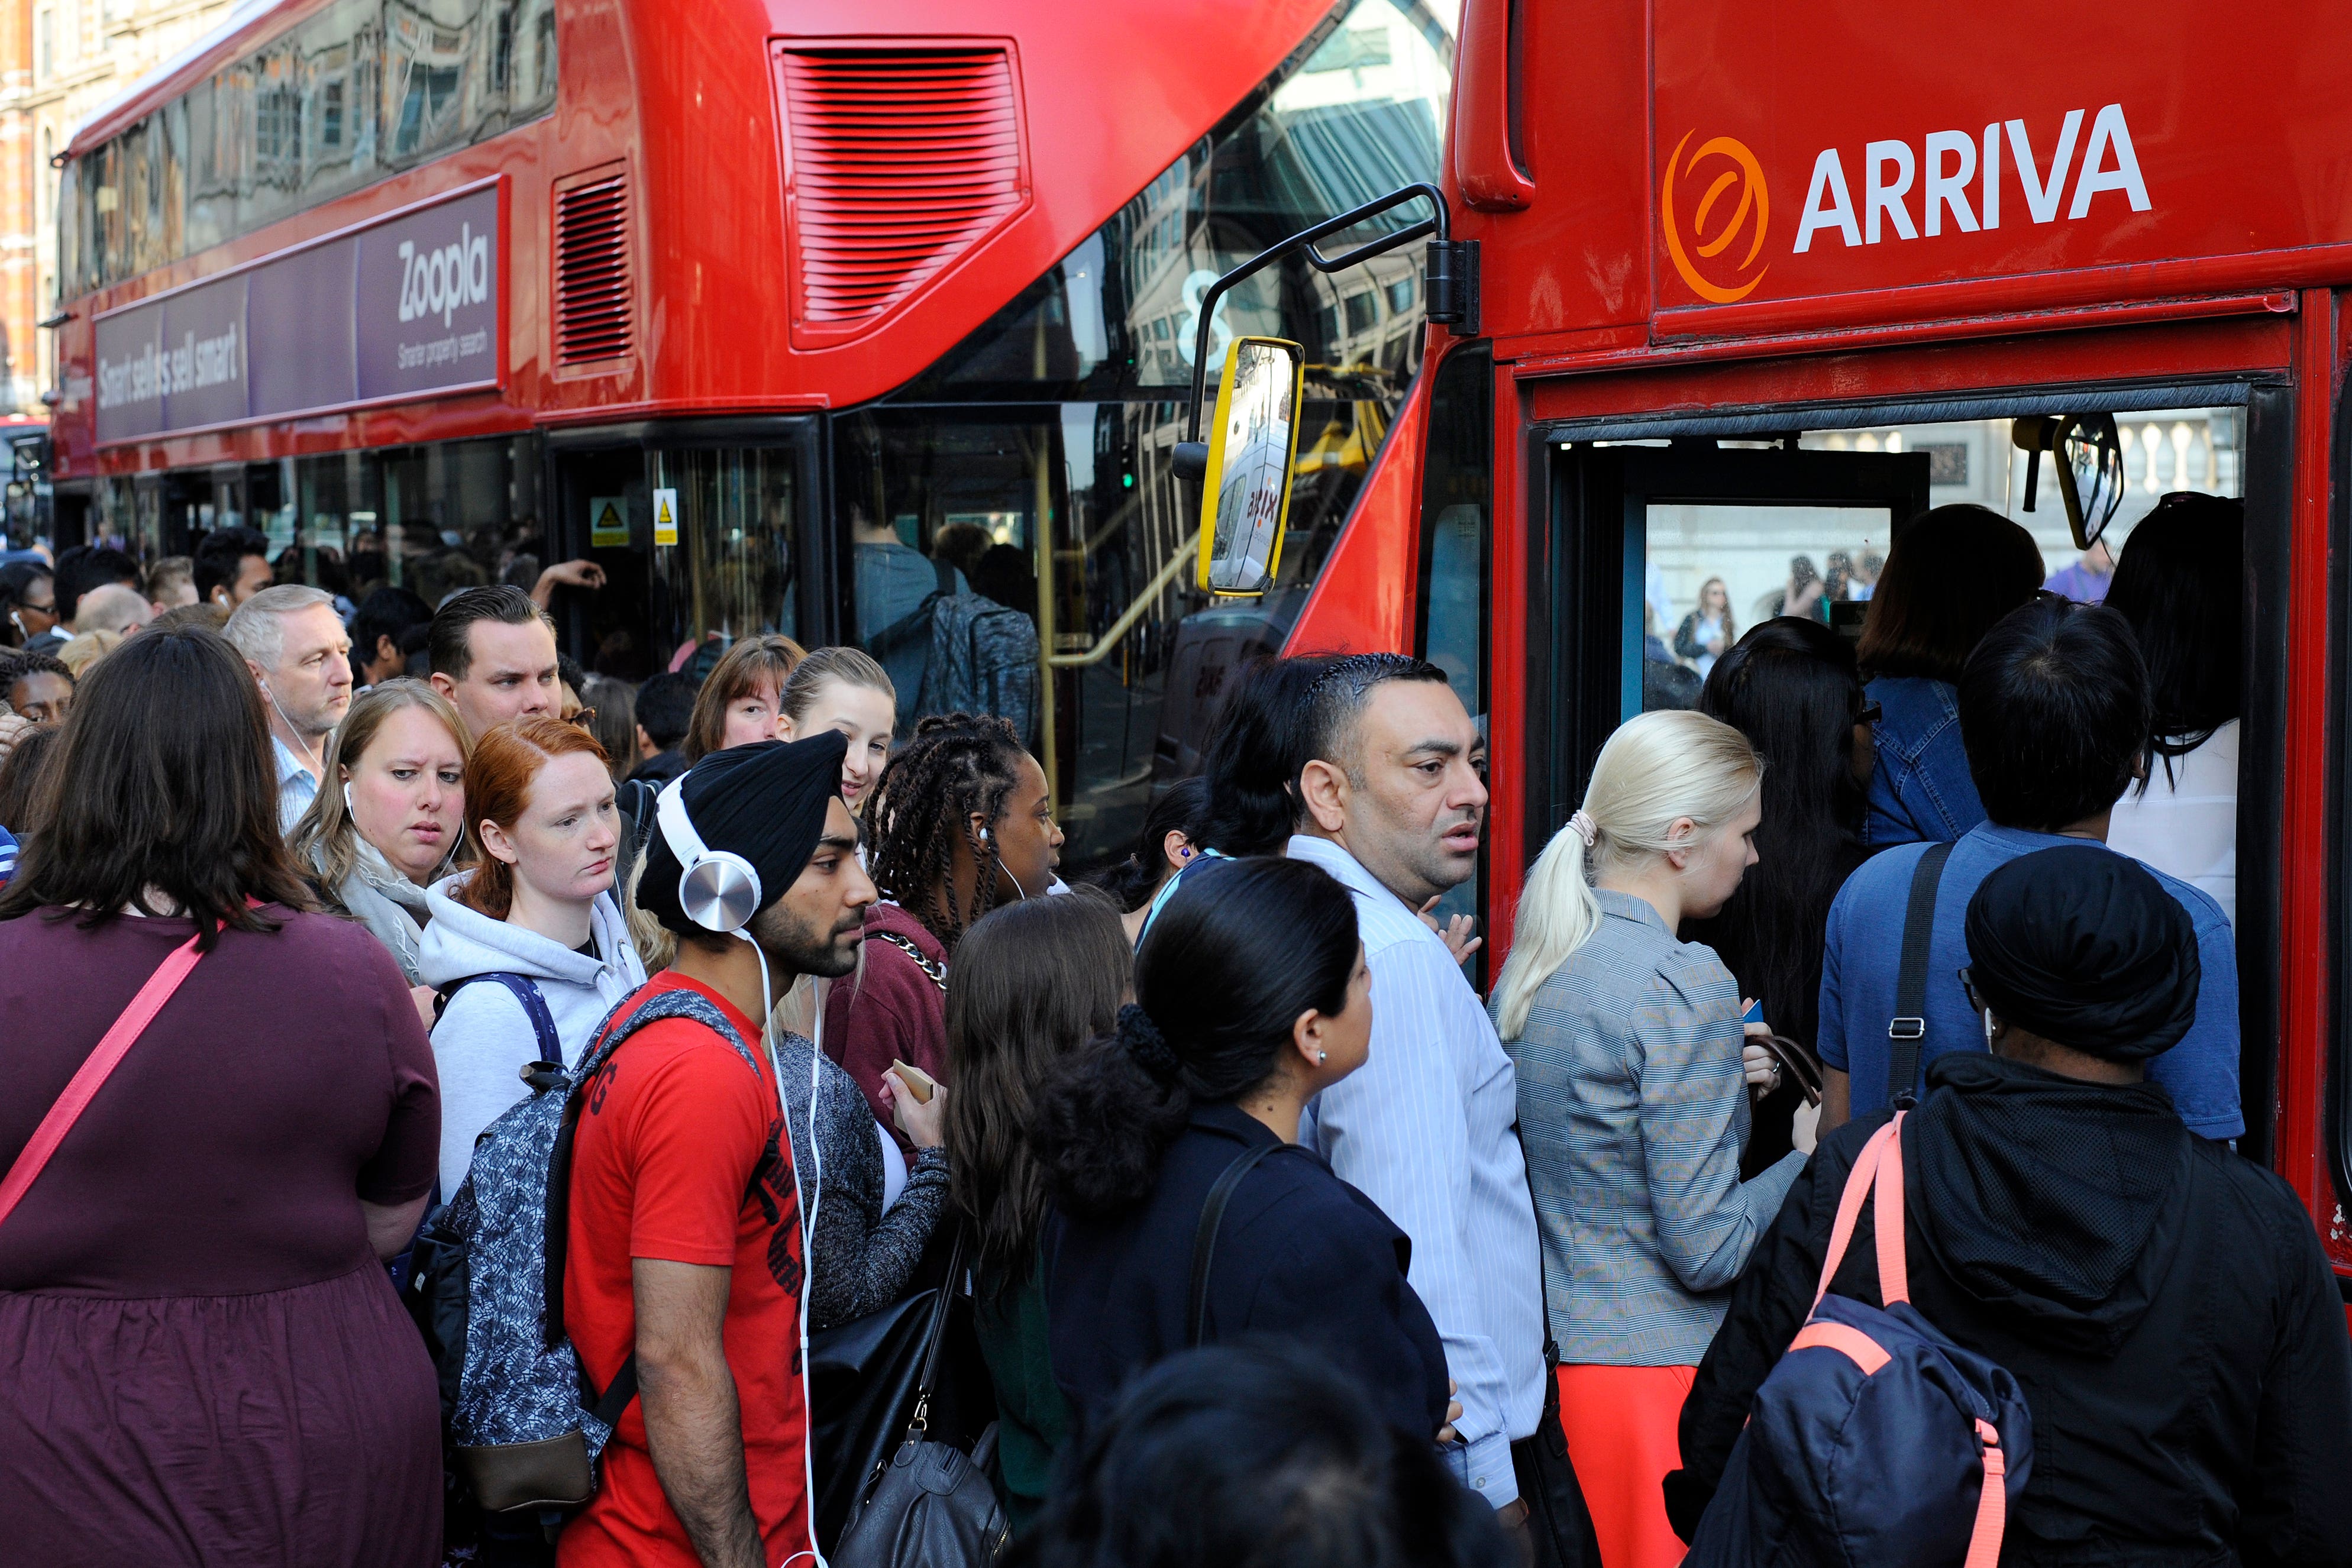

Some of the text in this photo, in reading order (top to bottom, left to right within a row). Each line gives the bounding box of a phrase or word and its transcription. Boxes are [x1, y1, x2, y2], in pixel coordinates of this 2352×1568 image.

[1792, 103, 2152, 254] ARRIVA
[398, 221, 488, 328] Zoopla
[1178, 269, 1233, 371] 8
[99, 353, 132, 409] Smart
[172, 330, 195, 395] sell
[196, 321, 237, 389] smart
[425, 332, 459, 368] property
[459, 326, 488, 357] search
